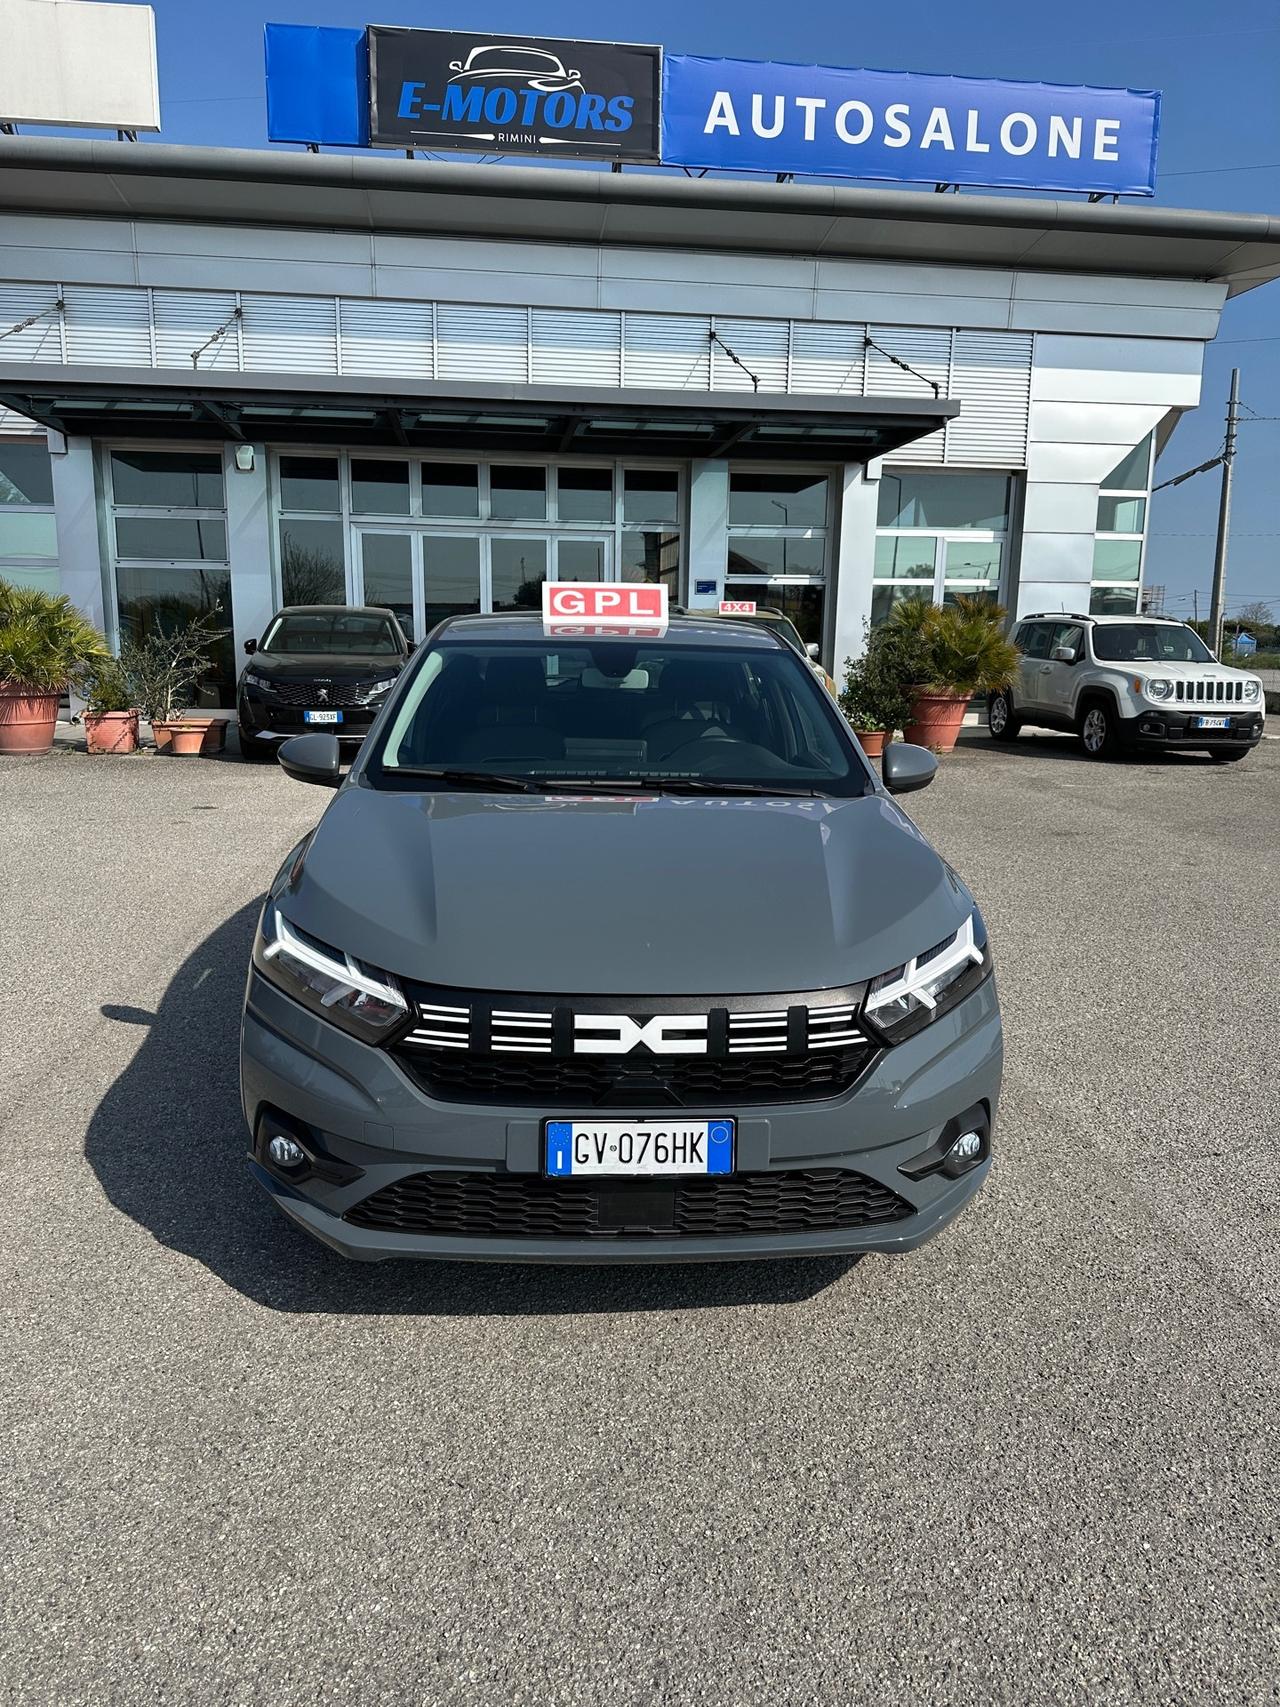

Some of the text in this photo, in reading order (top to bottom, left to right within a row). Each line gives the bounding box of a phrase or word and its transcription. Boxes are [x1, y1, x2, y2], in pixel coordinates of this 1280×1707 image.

[398, 81, 634, 132] E-MOTORS
[704, 91, 1121, 161] AUTOSALONE
[498, 133, 536, 144] RIMINI
[553, 591, 654, 615] GPL
[723, 603, 751, 612] 4X4
